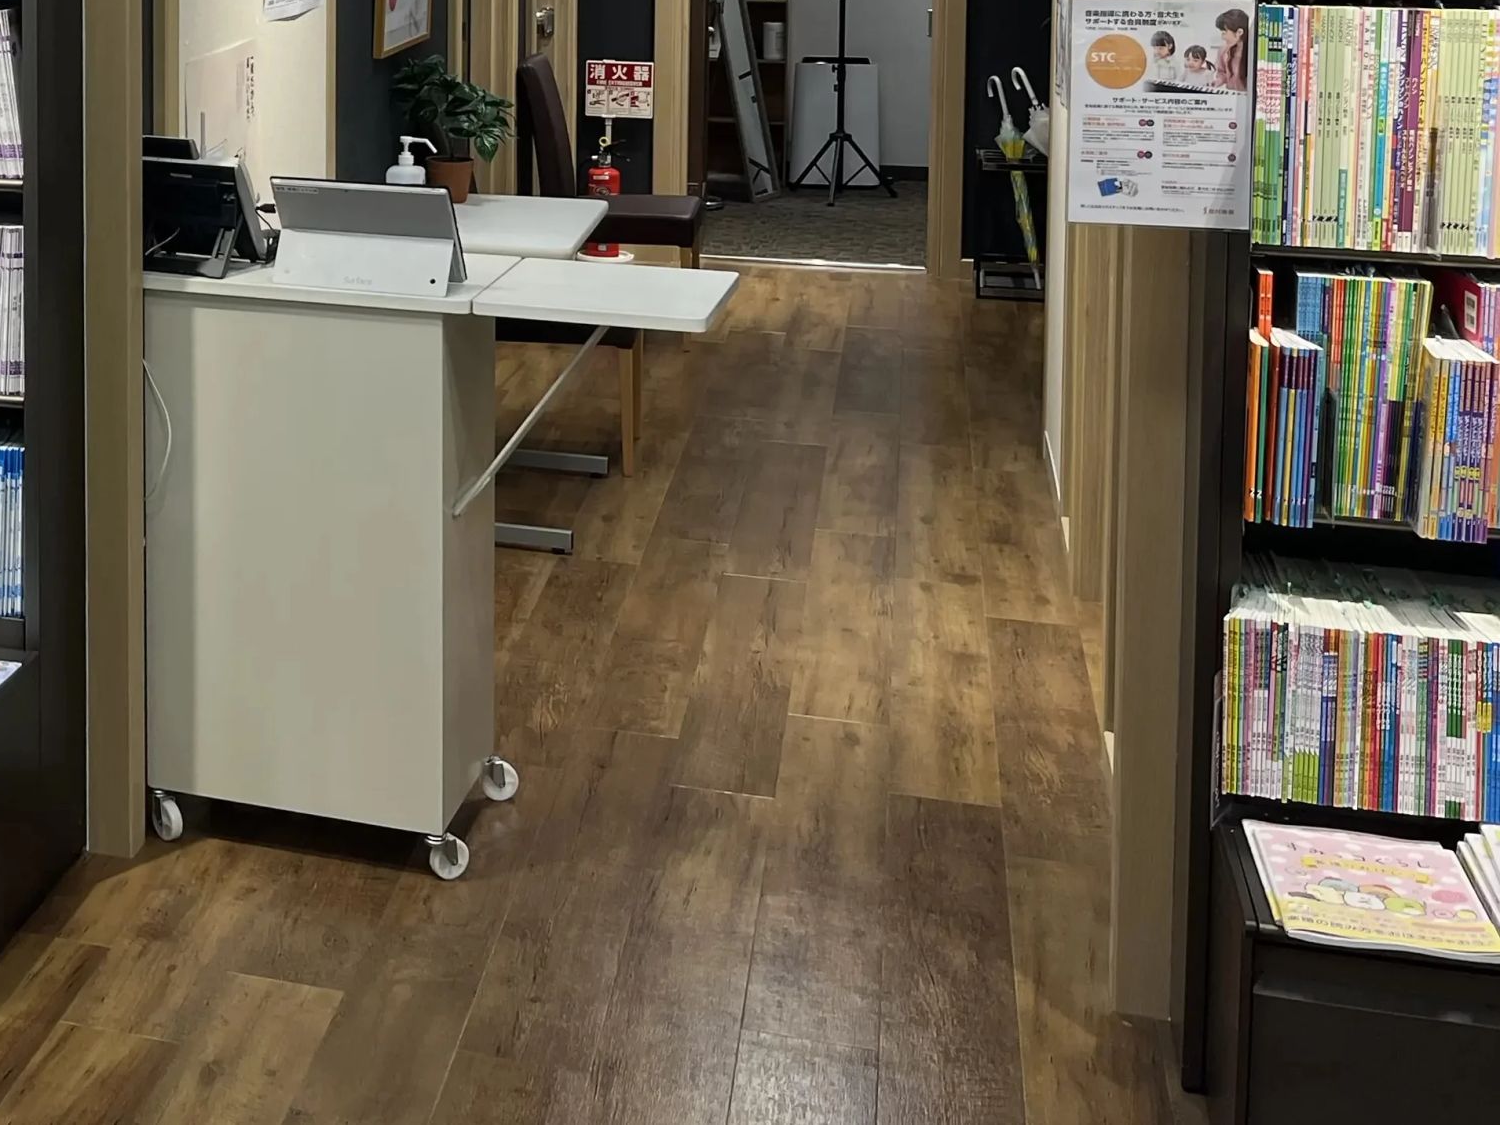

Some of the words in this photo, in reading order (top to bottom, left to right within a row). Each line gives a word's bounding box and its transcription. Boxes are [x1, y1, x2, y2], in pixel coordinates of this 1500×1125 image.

[1090, 52, 1117, 63] STC
[589, 63, 650, 82] 消火器
